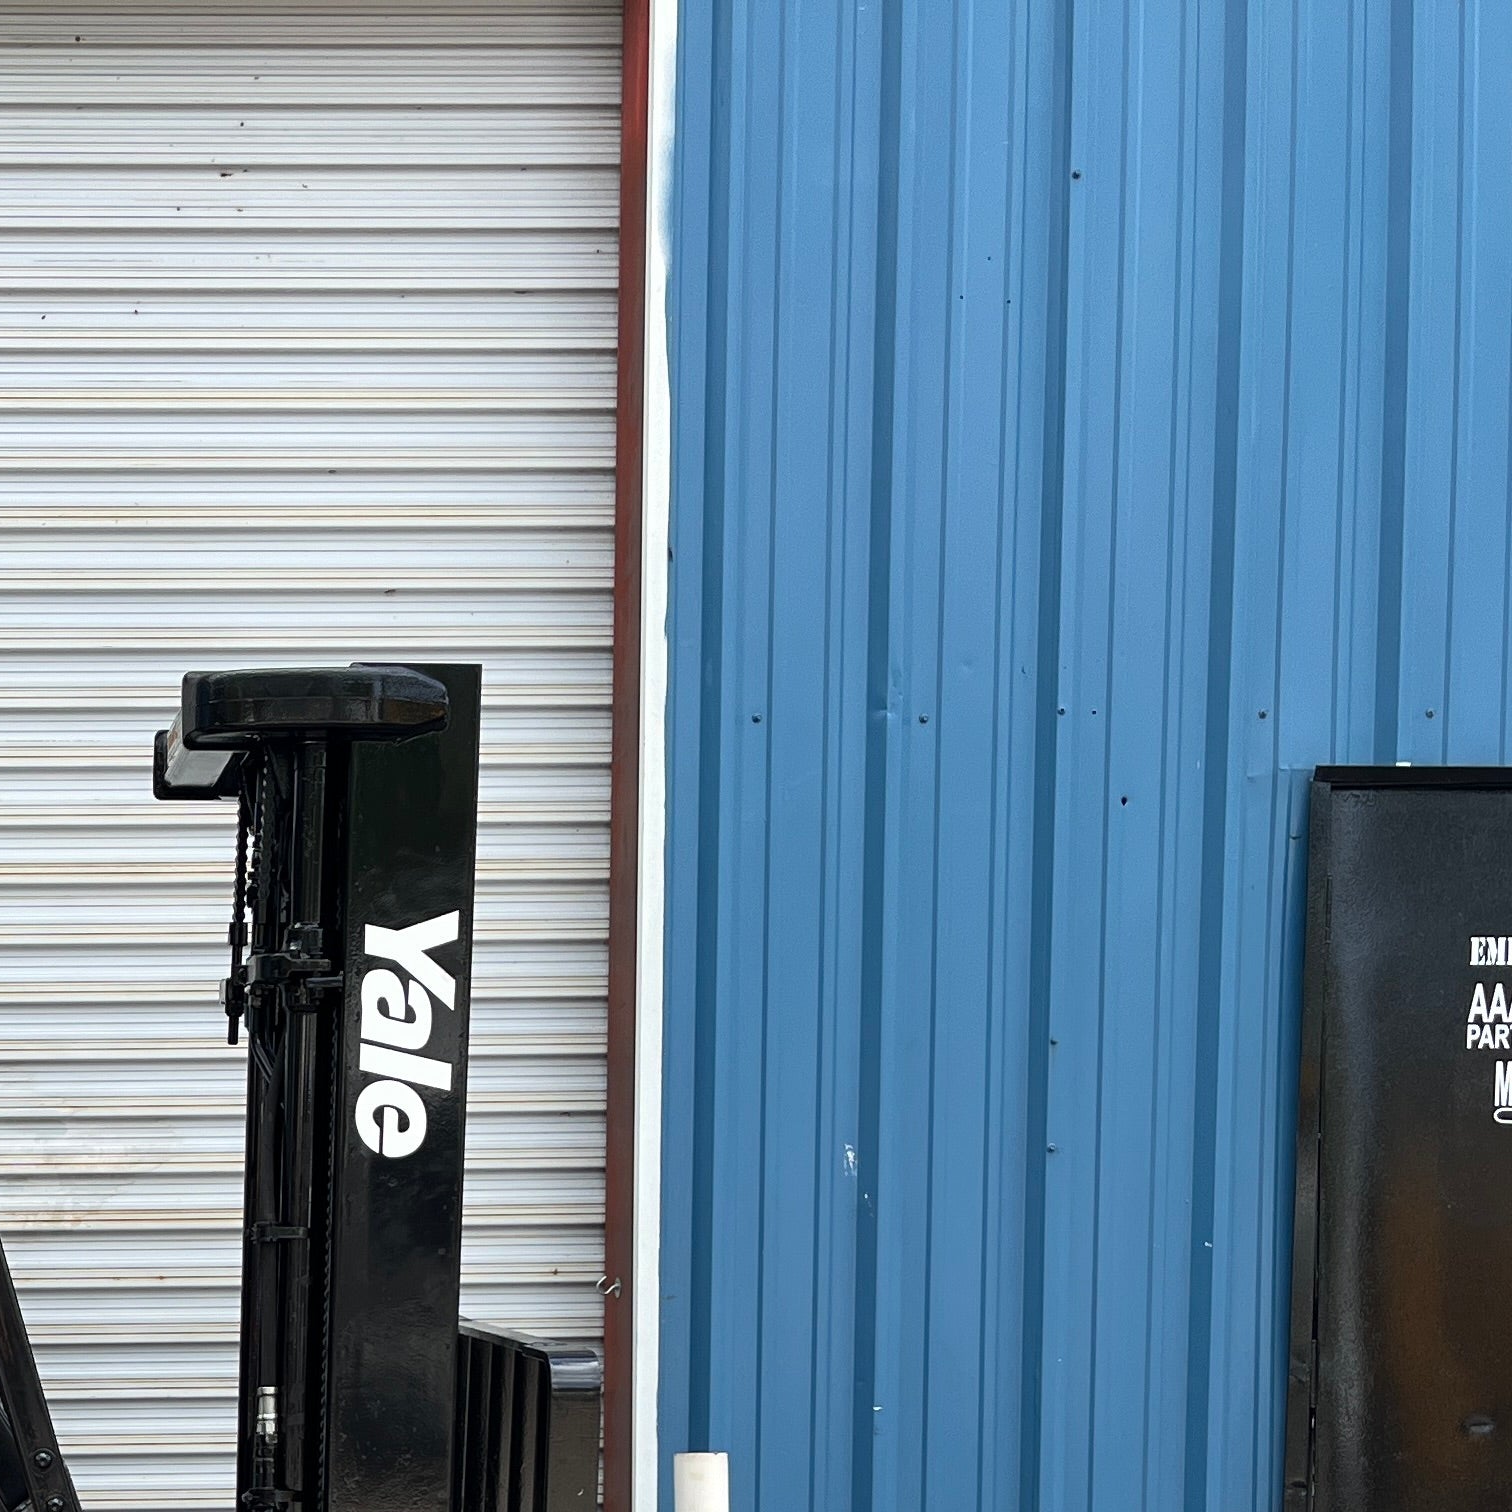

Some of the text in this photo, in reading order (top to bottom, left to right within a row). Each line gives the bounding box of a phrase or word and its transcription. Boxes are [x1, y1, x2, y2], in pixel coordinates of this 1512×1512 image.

[1467, 982, 1512, 1023] AA
[355, 909, 460, 1158] Yale
[1466, 1023, 1512, 1049] PAR
